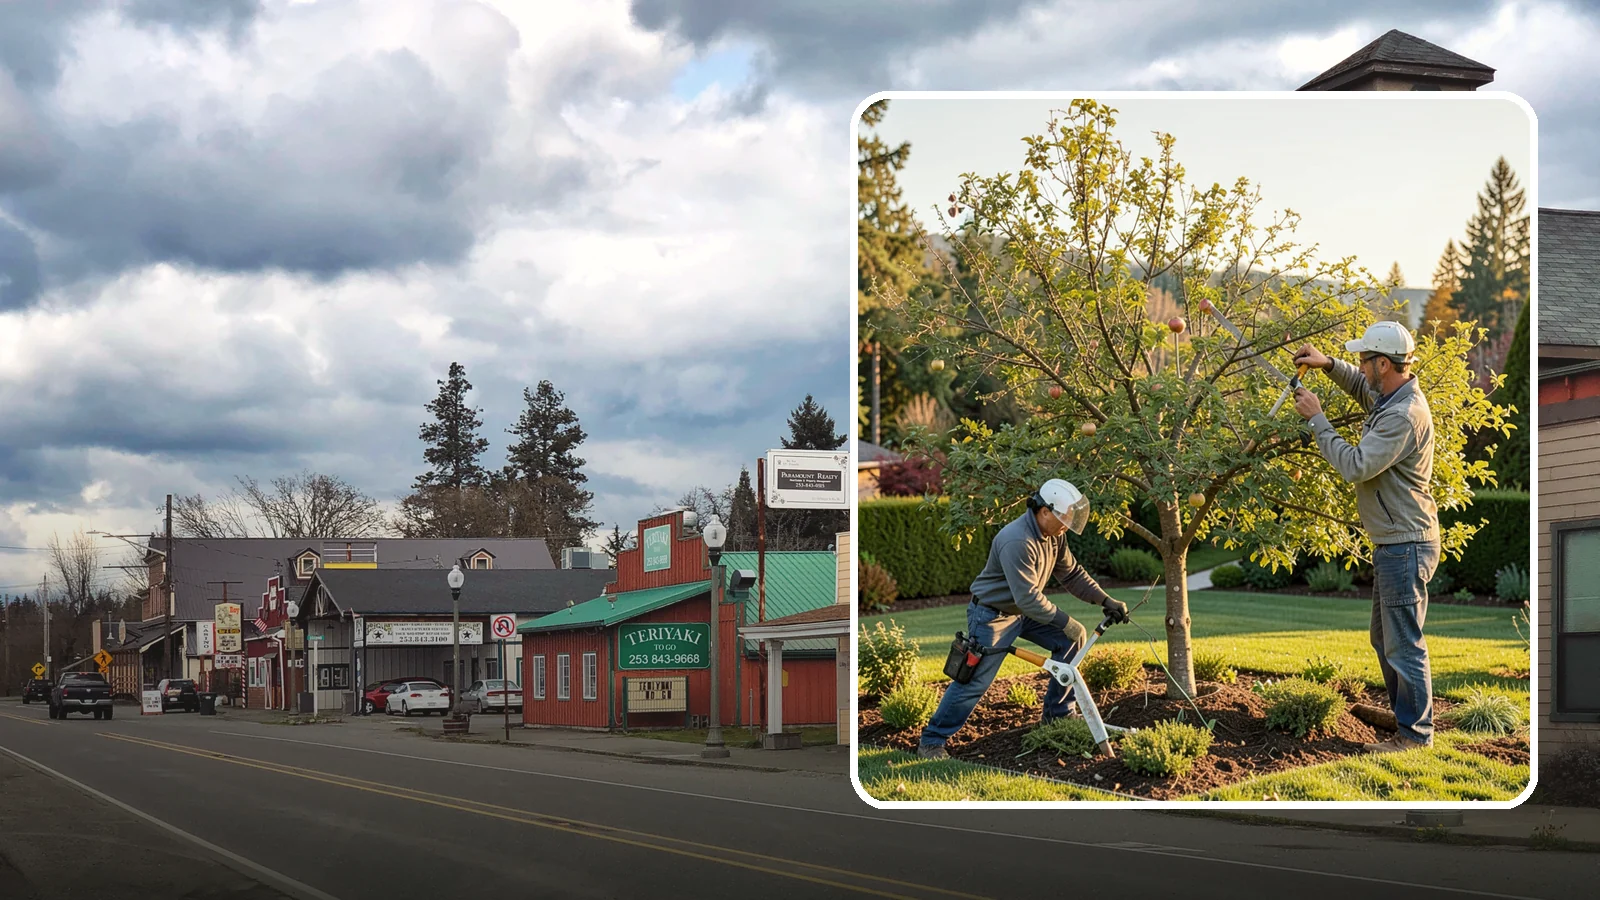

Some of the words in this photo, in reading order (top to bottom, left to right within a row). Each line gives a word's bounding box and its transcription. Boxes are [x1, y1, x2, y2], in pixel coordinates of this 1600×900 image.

[646, 531, 669, 549] TERIYAKI
[624, 627, 702, 646] TERIYAKI
[628, 654, 648, 665] 253
[651, 653, 700, 664] 843-9668
[639, 681, 672, 691] TERIYAKI
